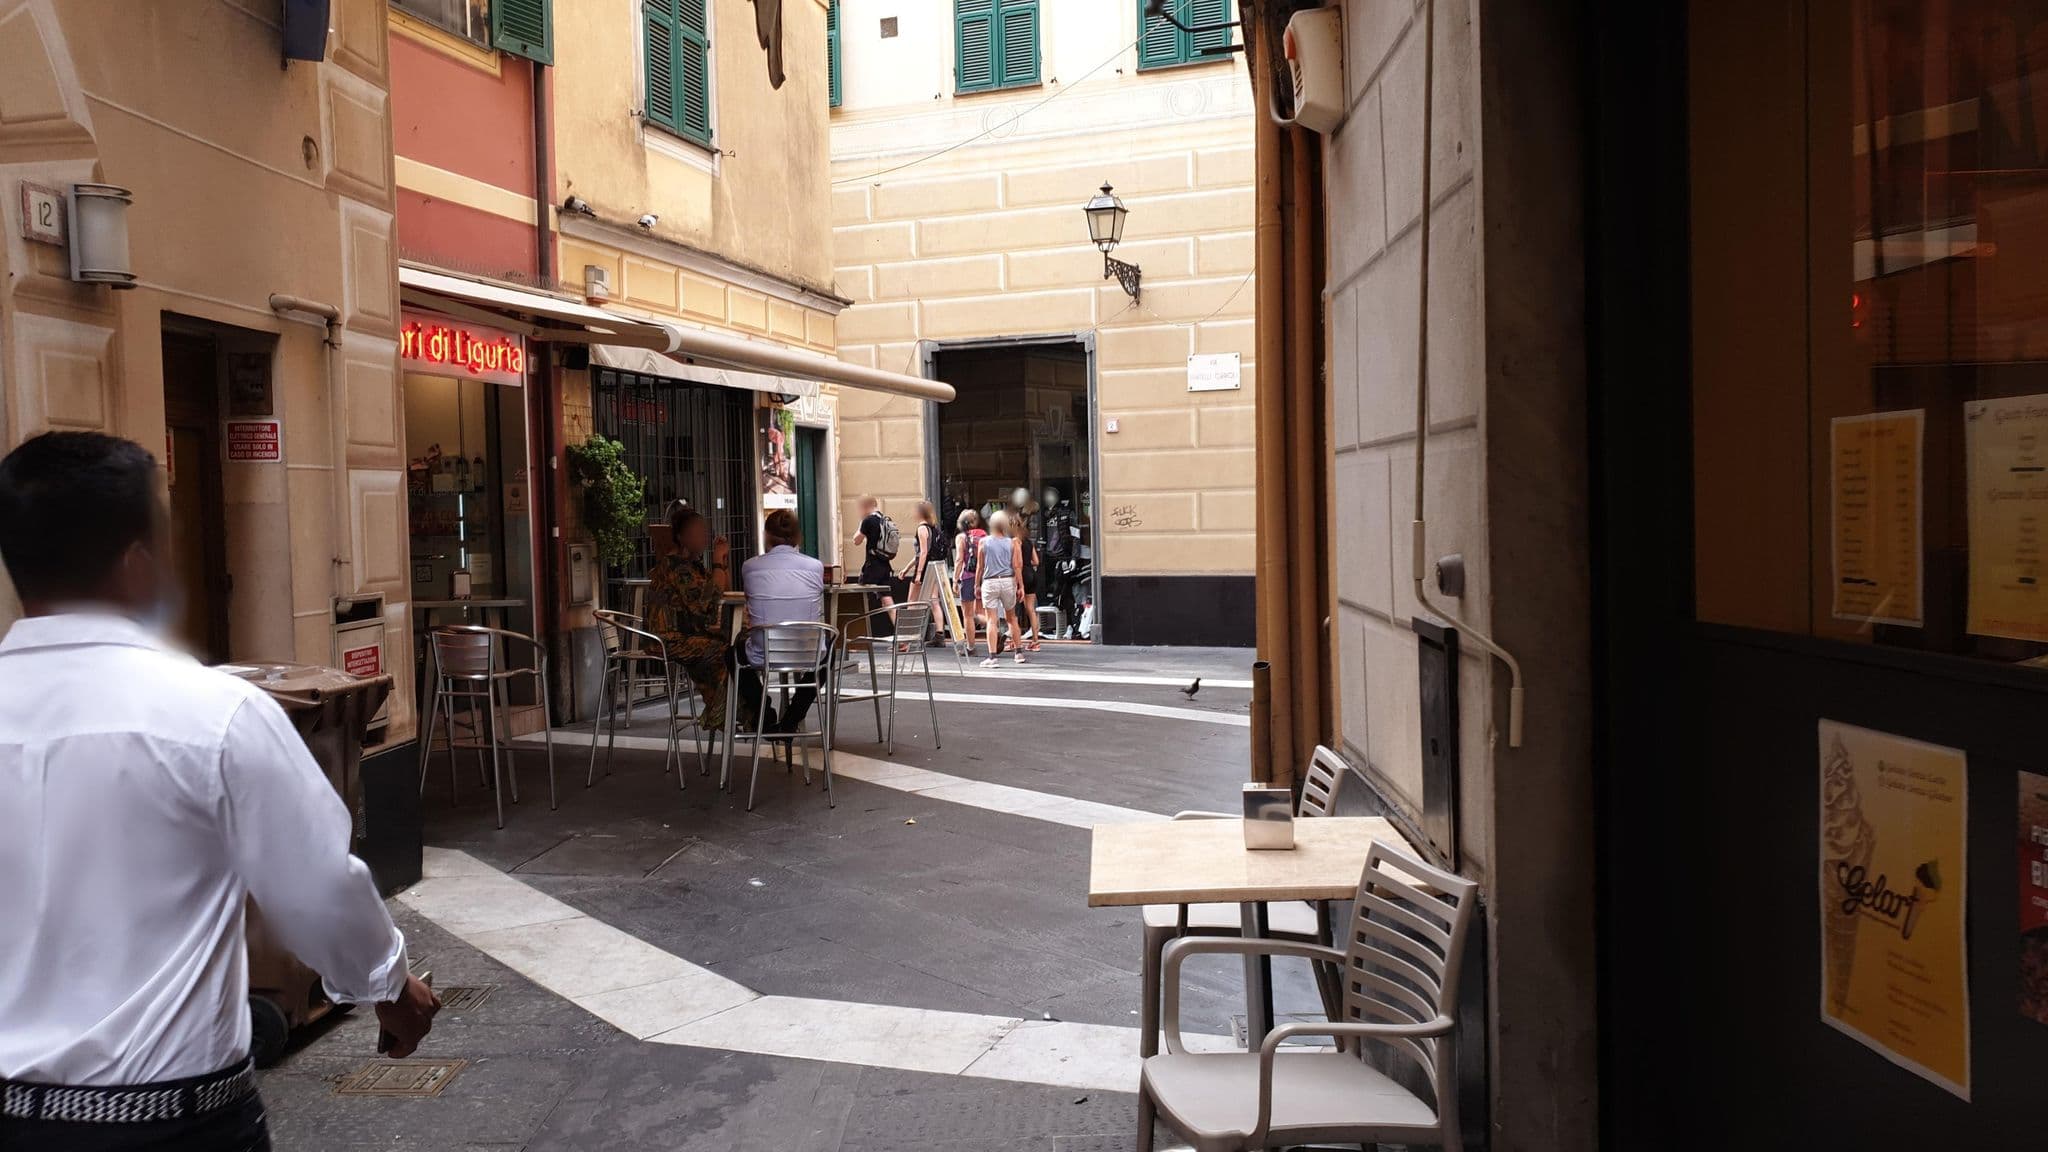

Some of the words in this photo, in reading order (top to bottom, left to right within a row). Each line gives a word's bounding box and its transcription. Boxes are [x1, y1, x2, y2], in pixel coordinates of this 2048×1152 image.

[39, 201, 52, 227] 12
[430, 327, 449, 361] di
[455, 330, 524, 373] Liguria
[253, 432, 277, 440] GENERALE
[1837, 861, 1921, 940] Gelart
